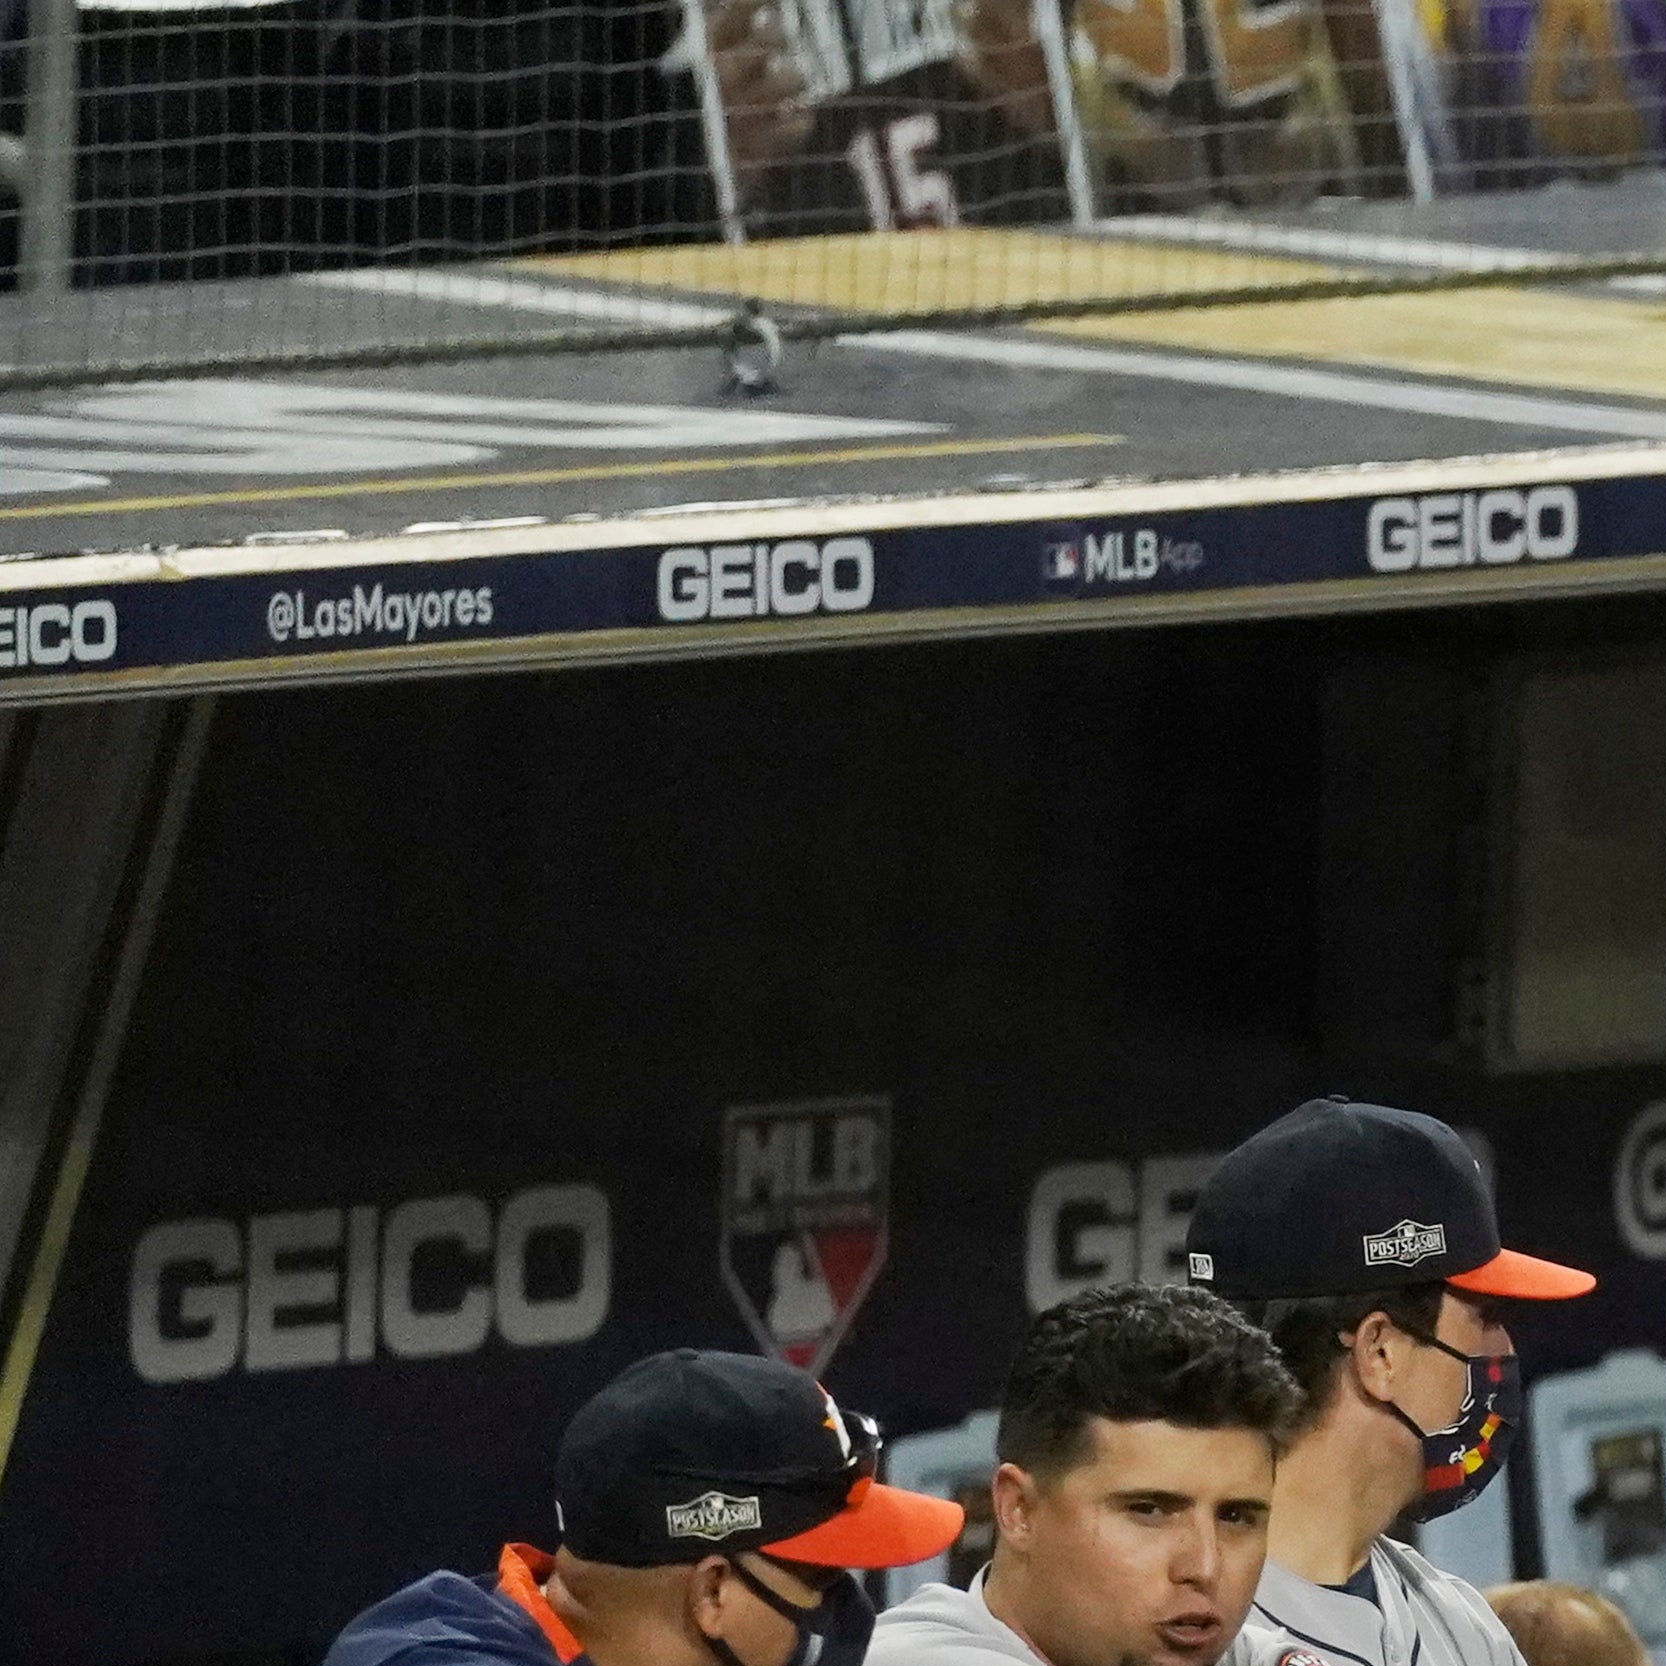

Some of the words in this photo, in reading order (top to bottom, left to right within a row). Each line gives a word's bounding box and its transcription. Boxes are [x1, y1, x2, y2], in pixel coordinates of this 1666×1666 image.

[1083, 528, 1160, 584] MLB
[1366, 485, 1578, 573] GEICO
[267, 583, 494, 642] @LasMayores
[657, 537, 874, 623] GEICO
[1369, 1230, 1443, 1258] POSTSEASON
[128, 1184, 611, 1385] GEICO
